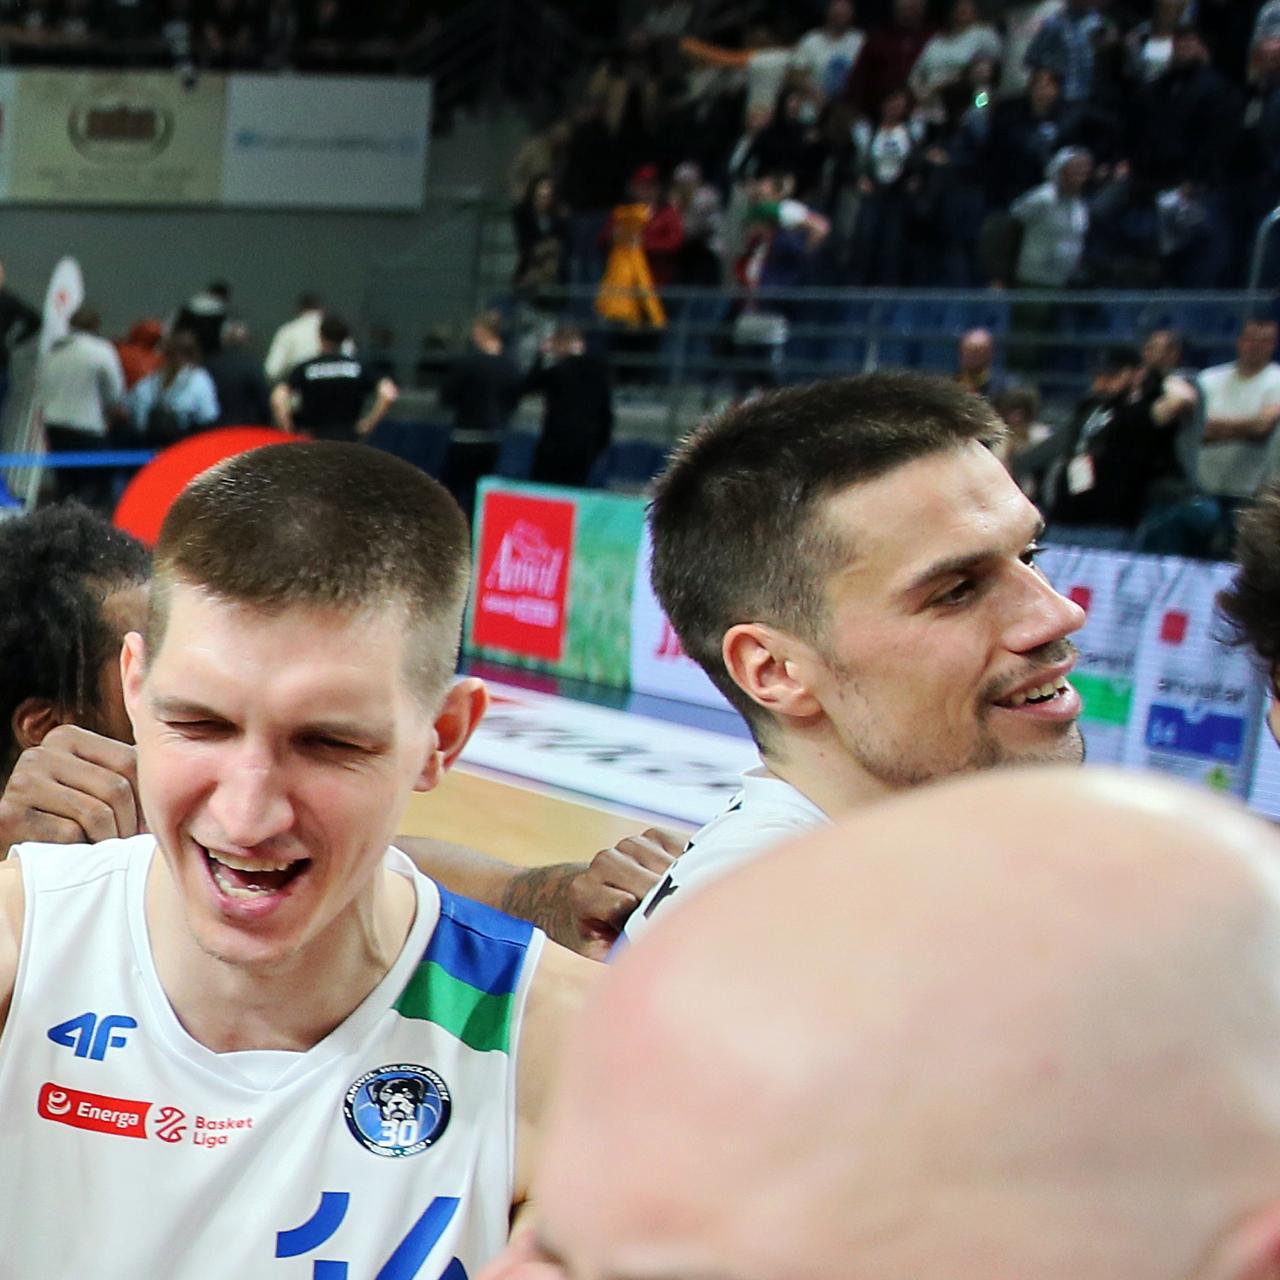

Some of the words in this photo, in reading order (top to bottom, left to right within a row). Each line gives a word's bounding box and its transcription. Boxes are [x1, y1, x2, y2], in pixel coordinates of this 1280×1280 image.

[47, 1012, 138, 1061] 4F
[76, 1101, 140, 1129] Energa
[195, 1115, 254, 1131] Basket
[193, 1131, 229, 1149] Liga
[379, 1119, 419, 1148] 30
